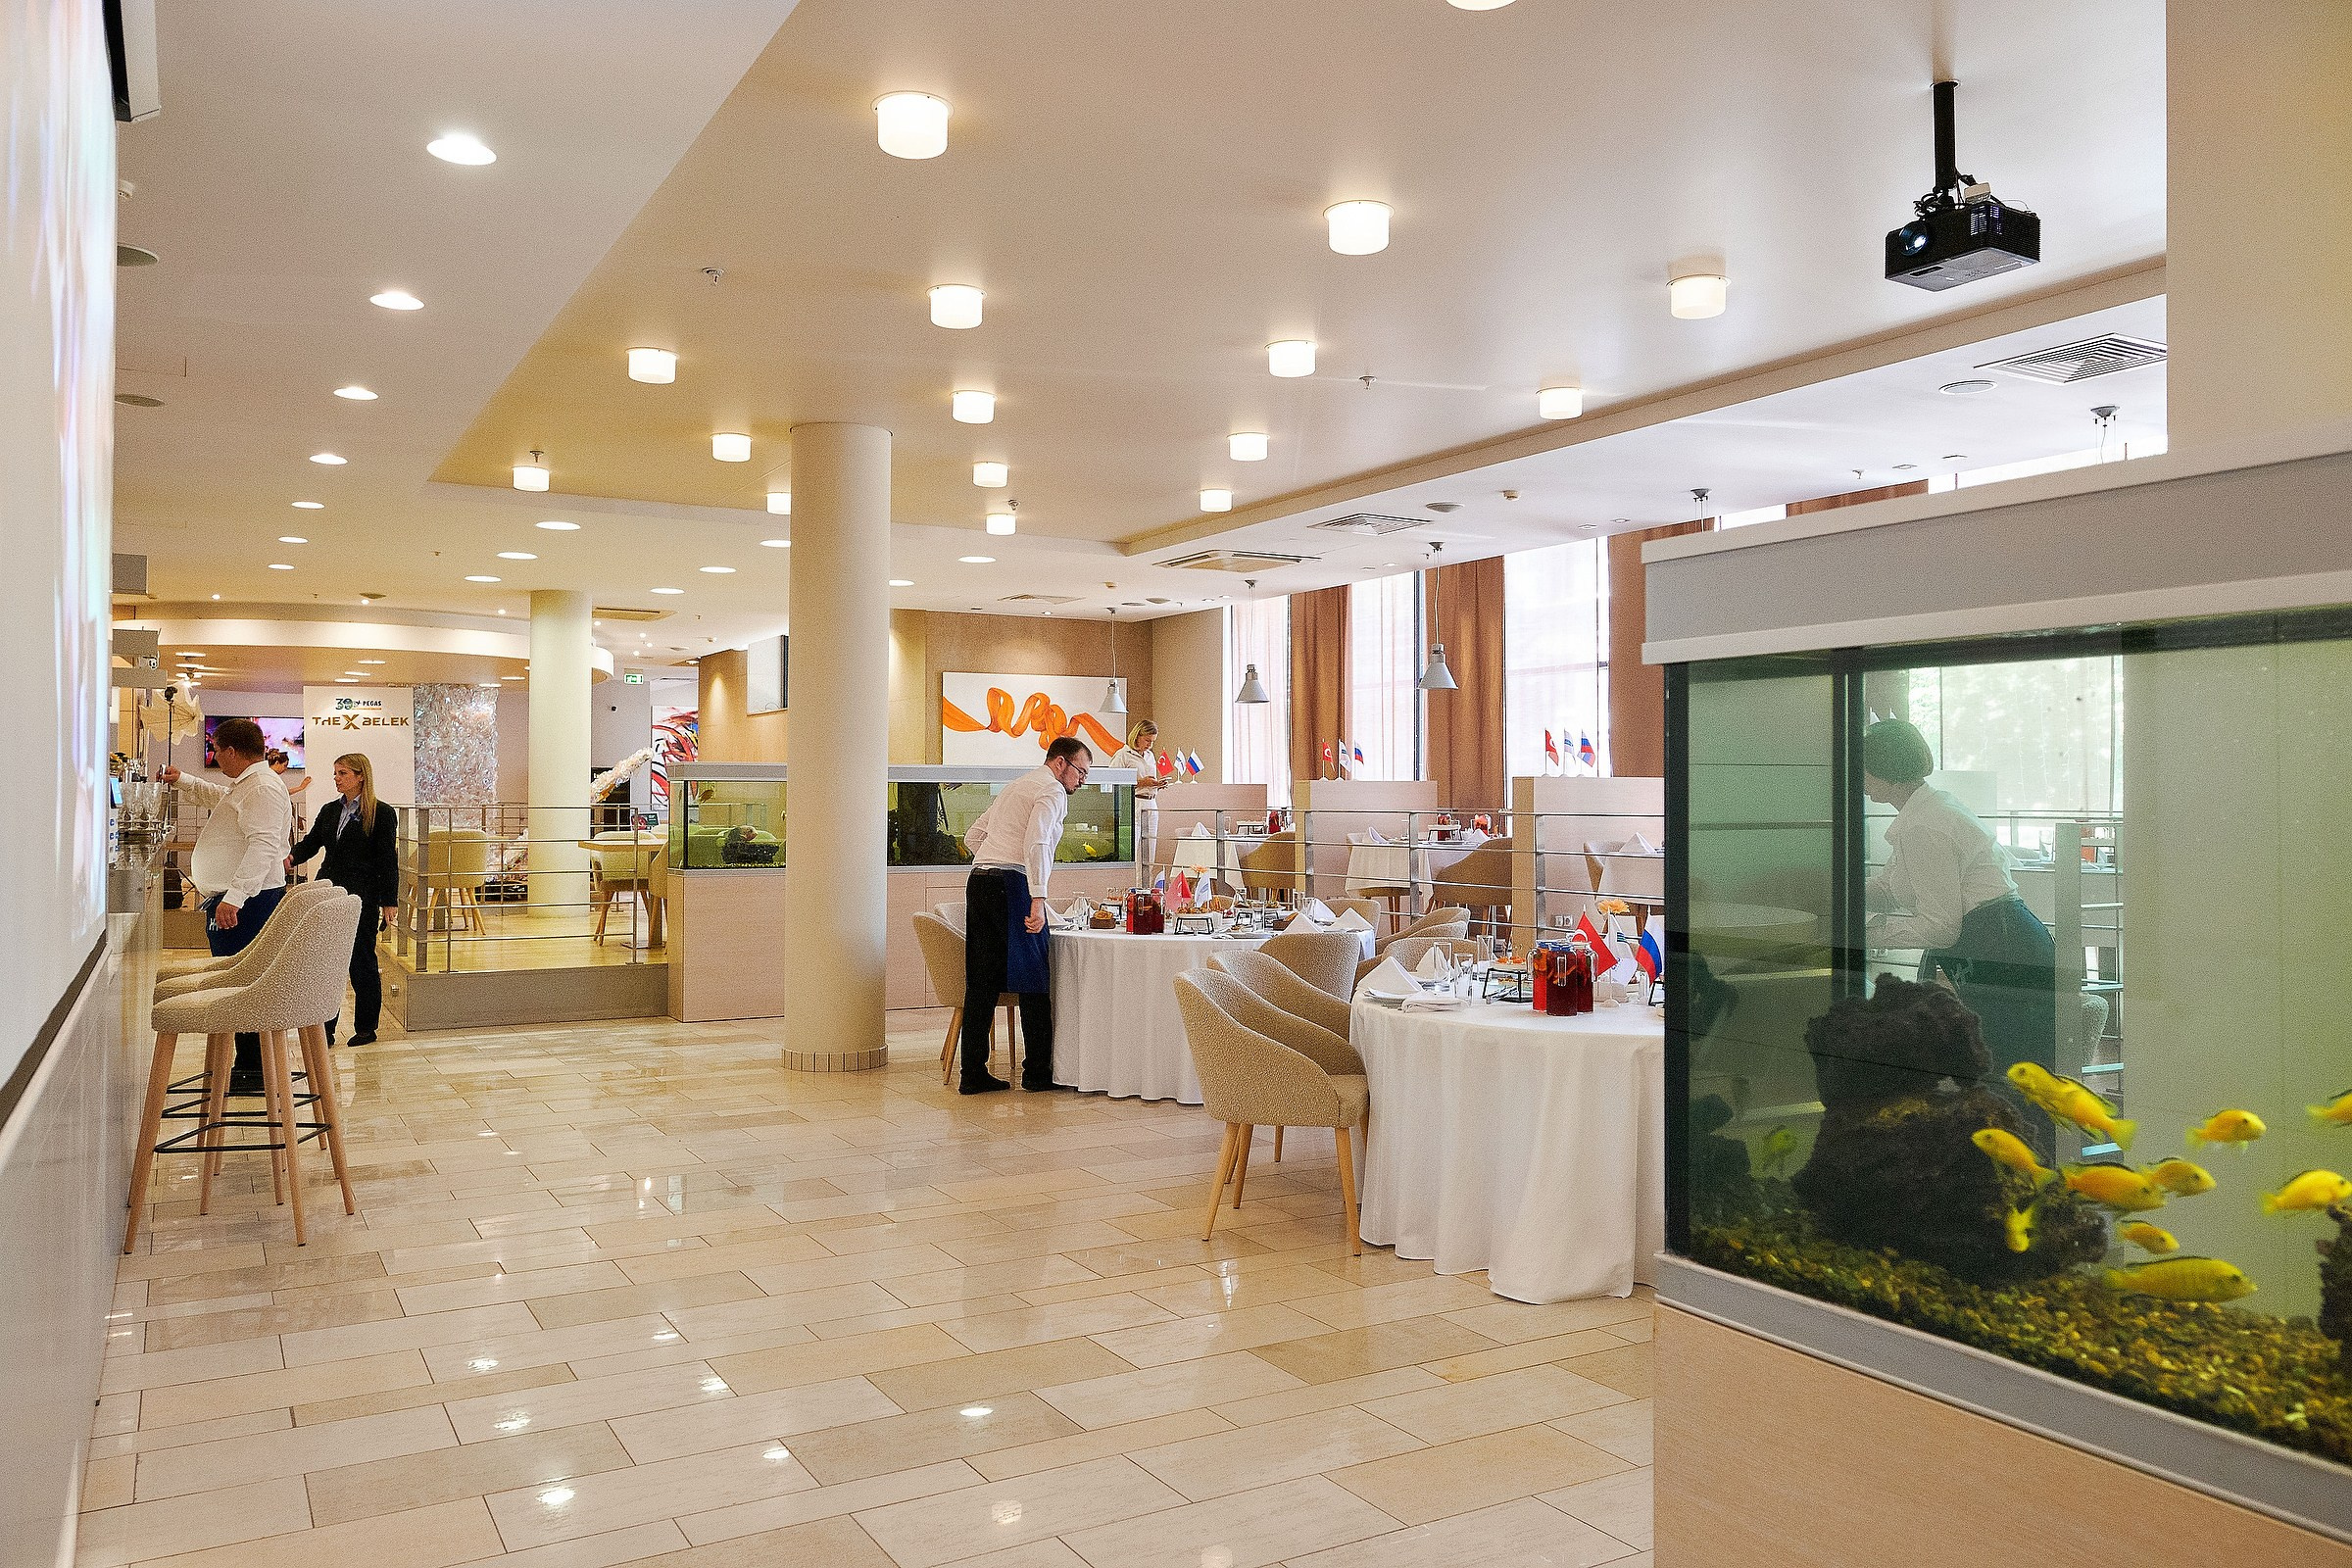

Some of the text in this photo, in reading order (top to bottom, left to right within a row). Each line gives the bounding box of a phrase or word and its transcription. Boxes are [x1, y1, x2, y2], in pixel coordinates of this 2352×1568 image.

[312, 713, 410, 730] THE X BELEK
